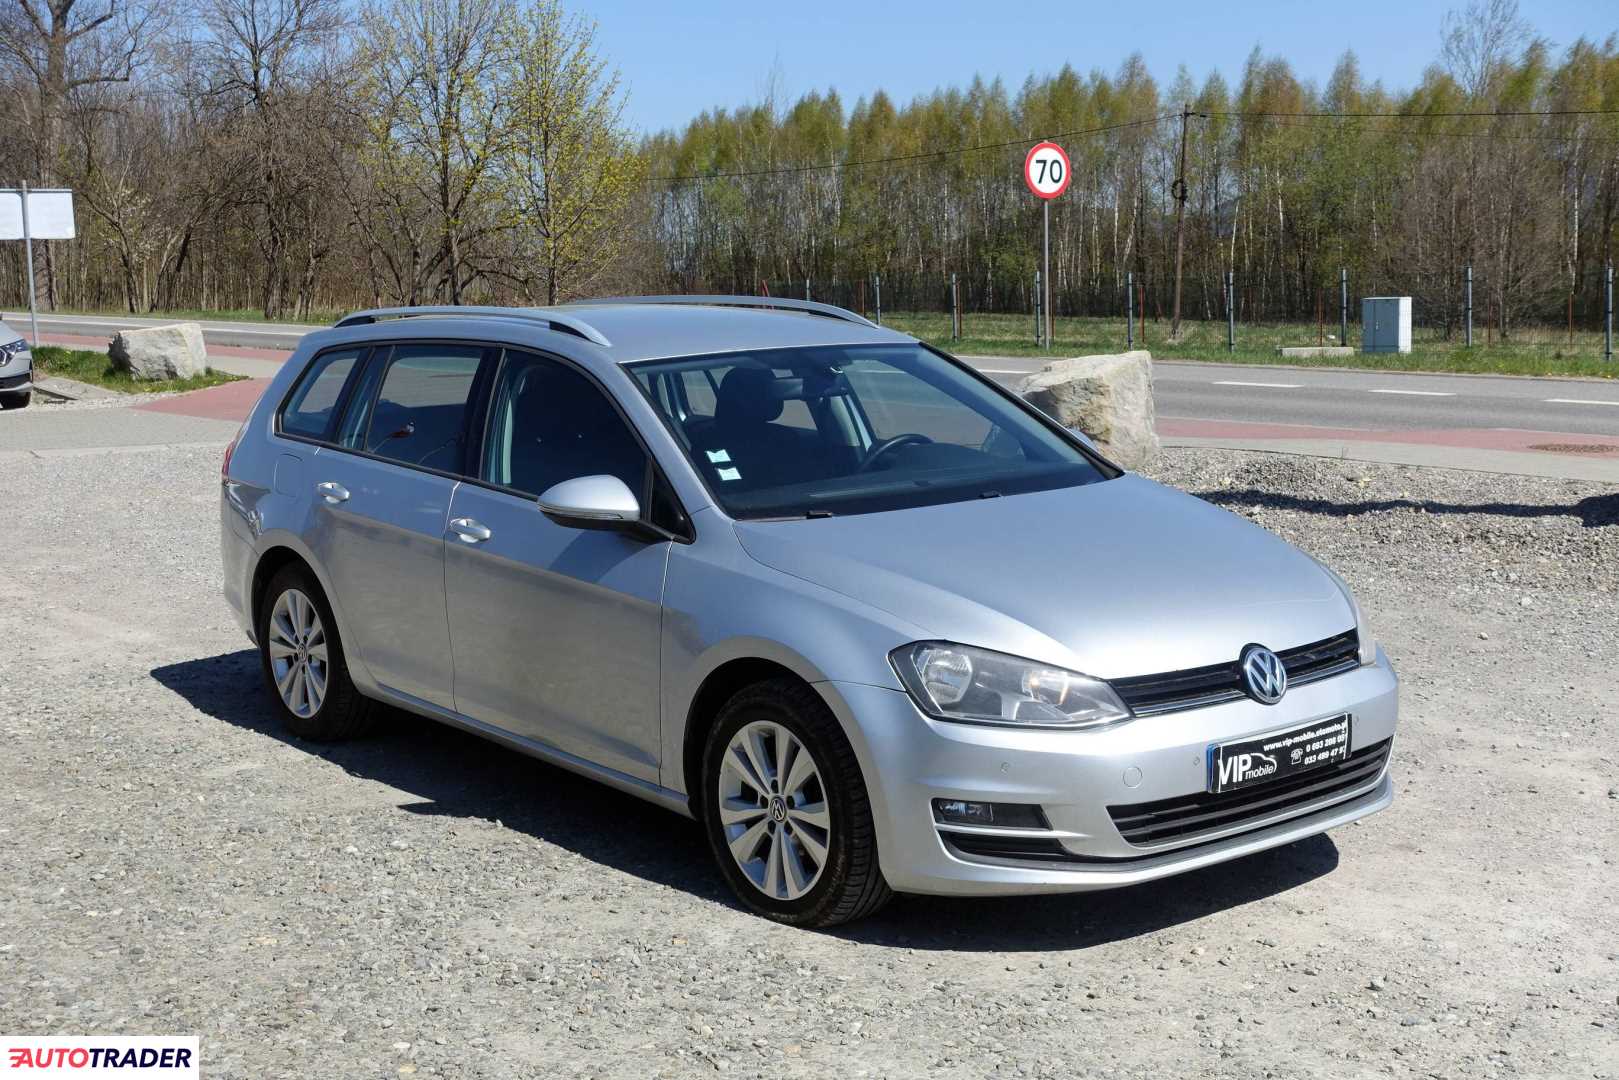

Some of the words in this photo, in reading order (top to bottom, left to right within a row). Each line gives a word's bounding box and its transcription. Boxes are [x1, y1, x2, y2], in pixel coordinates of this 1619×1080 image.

[1035, 159, 1063, 184] 70
[1218, 753, 1252, 785] VIP
[1245, 764, 1274, 780] mobile
